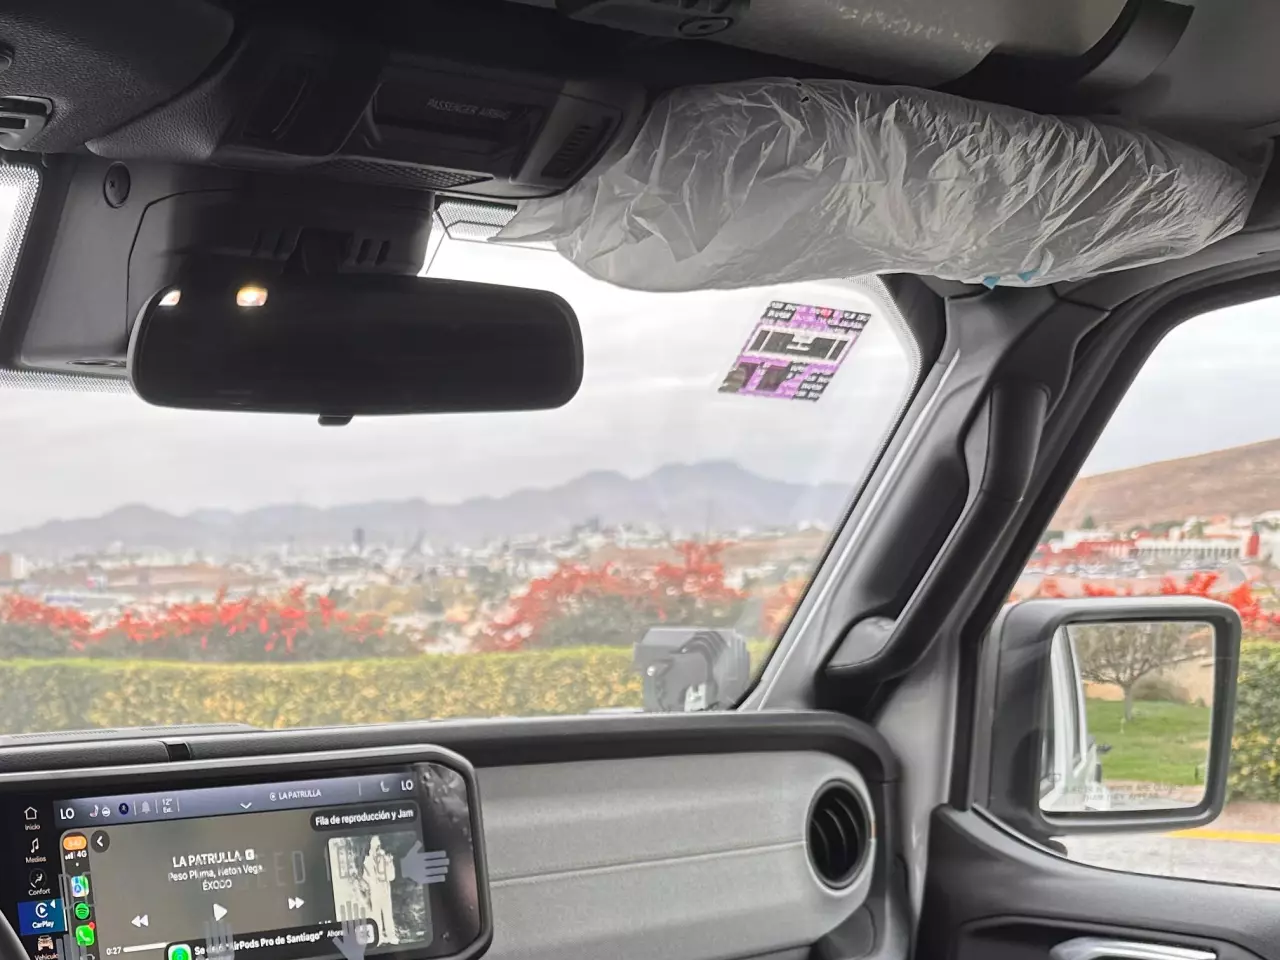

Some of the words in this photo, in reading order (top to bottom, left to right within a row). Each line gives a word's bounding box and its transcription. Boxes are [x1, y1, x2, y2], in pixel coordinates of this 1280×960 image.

[401, 779, 414, 791] LO
[278, 792, 288, 800] LA
[288, 789, 322, 800] PATRULLA
[60, 807, 75, 820] LO
[315, 816, 329, 826] Fila
[330, 815, 341, 825] de
[342, 810, 390, 825] reproducción
[391, 812, 397, 821] y
[397, 809, 414, 818] Jam
[76, 850, 87, 858] 4G
[172, 855, 190, 868] LA
[188, 850, 242, 866] PATRULLA
[25, 856, 47, 864] Medios
[168, 872, 188, 882] Peso
[243, 864, 263, 875] Vega
[202, 879, 232, 891] ÉXODO
[28, 888, 51, 896] Confort
[32, 920, 54, 929] CarPlay
[260, 937, 275, 949] Pro
[275, 935, 286, 946] de
[106, 946, 122, 956] 0:27
[194, 946, 206, 956] Se
